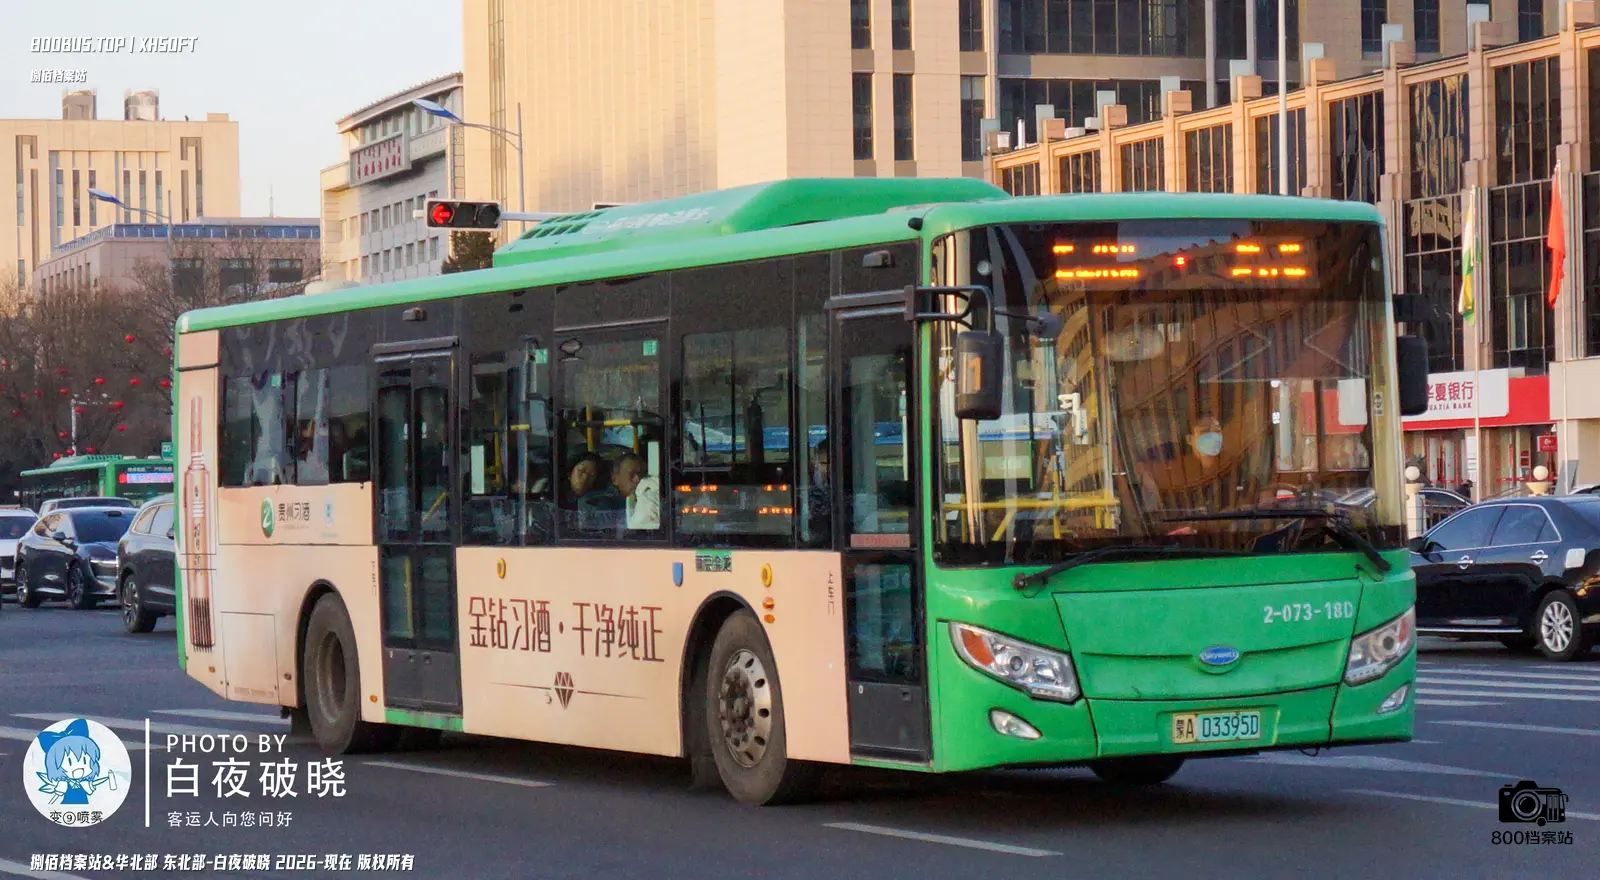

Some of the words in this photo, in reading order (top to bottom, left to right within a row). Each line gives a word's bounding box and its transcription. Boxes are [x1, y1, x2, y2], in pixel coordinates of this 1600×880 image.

[1427, 403, 1450, 411] UAXIA
[1453, 402, 1472, 410] BANK
[278, 502, 310, 522] 贵州习酒
[1263, 601, 1354, 624] 2-073-18D
